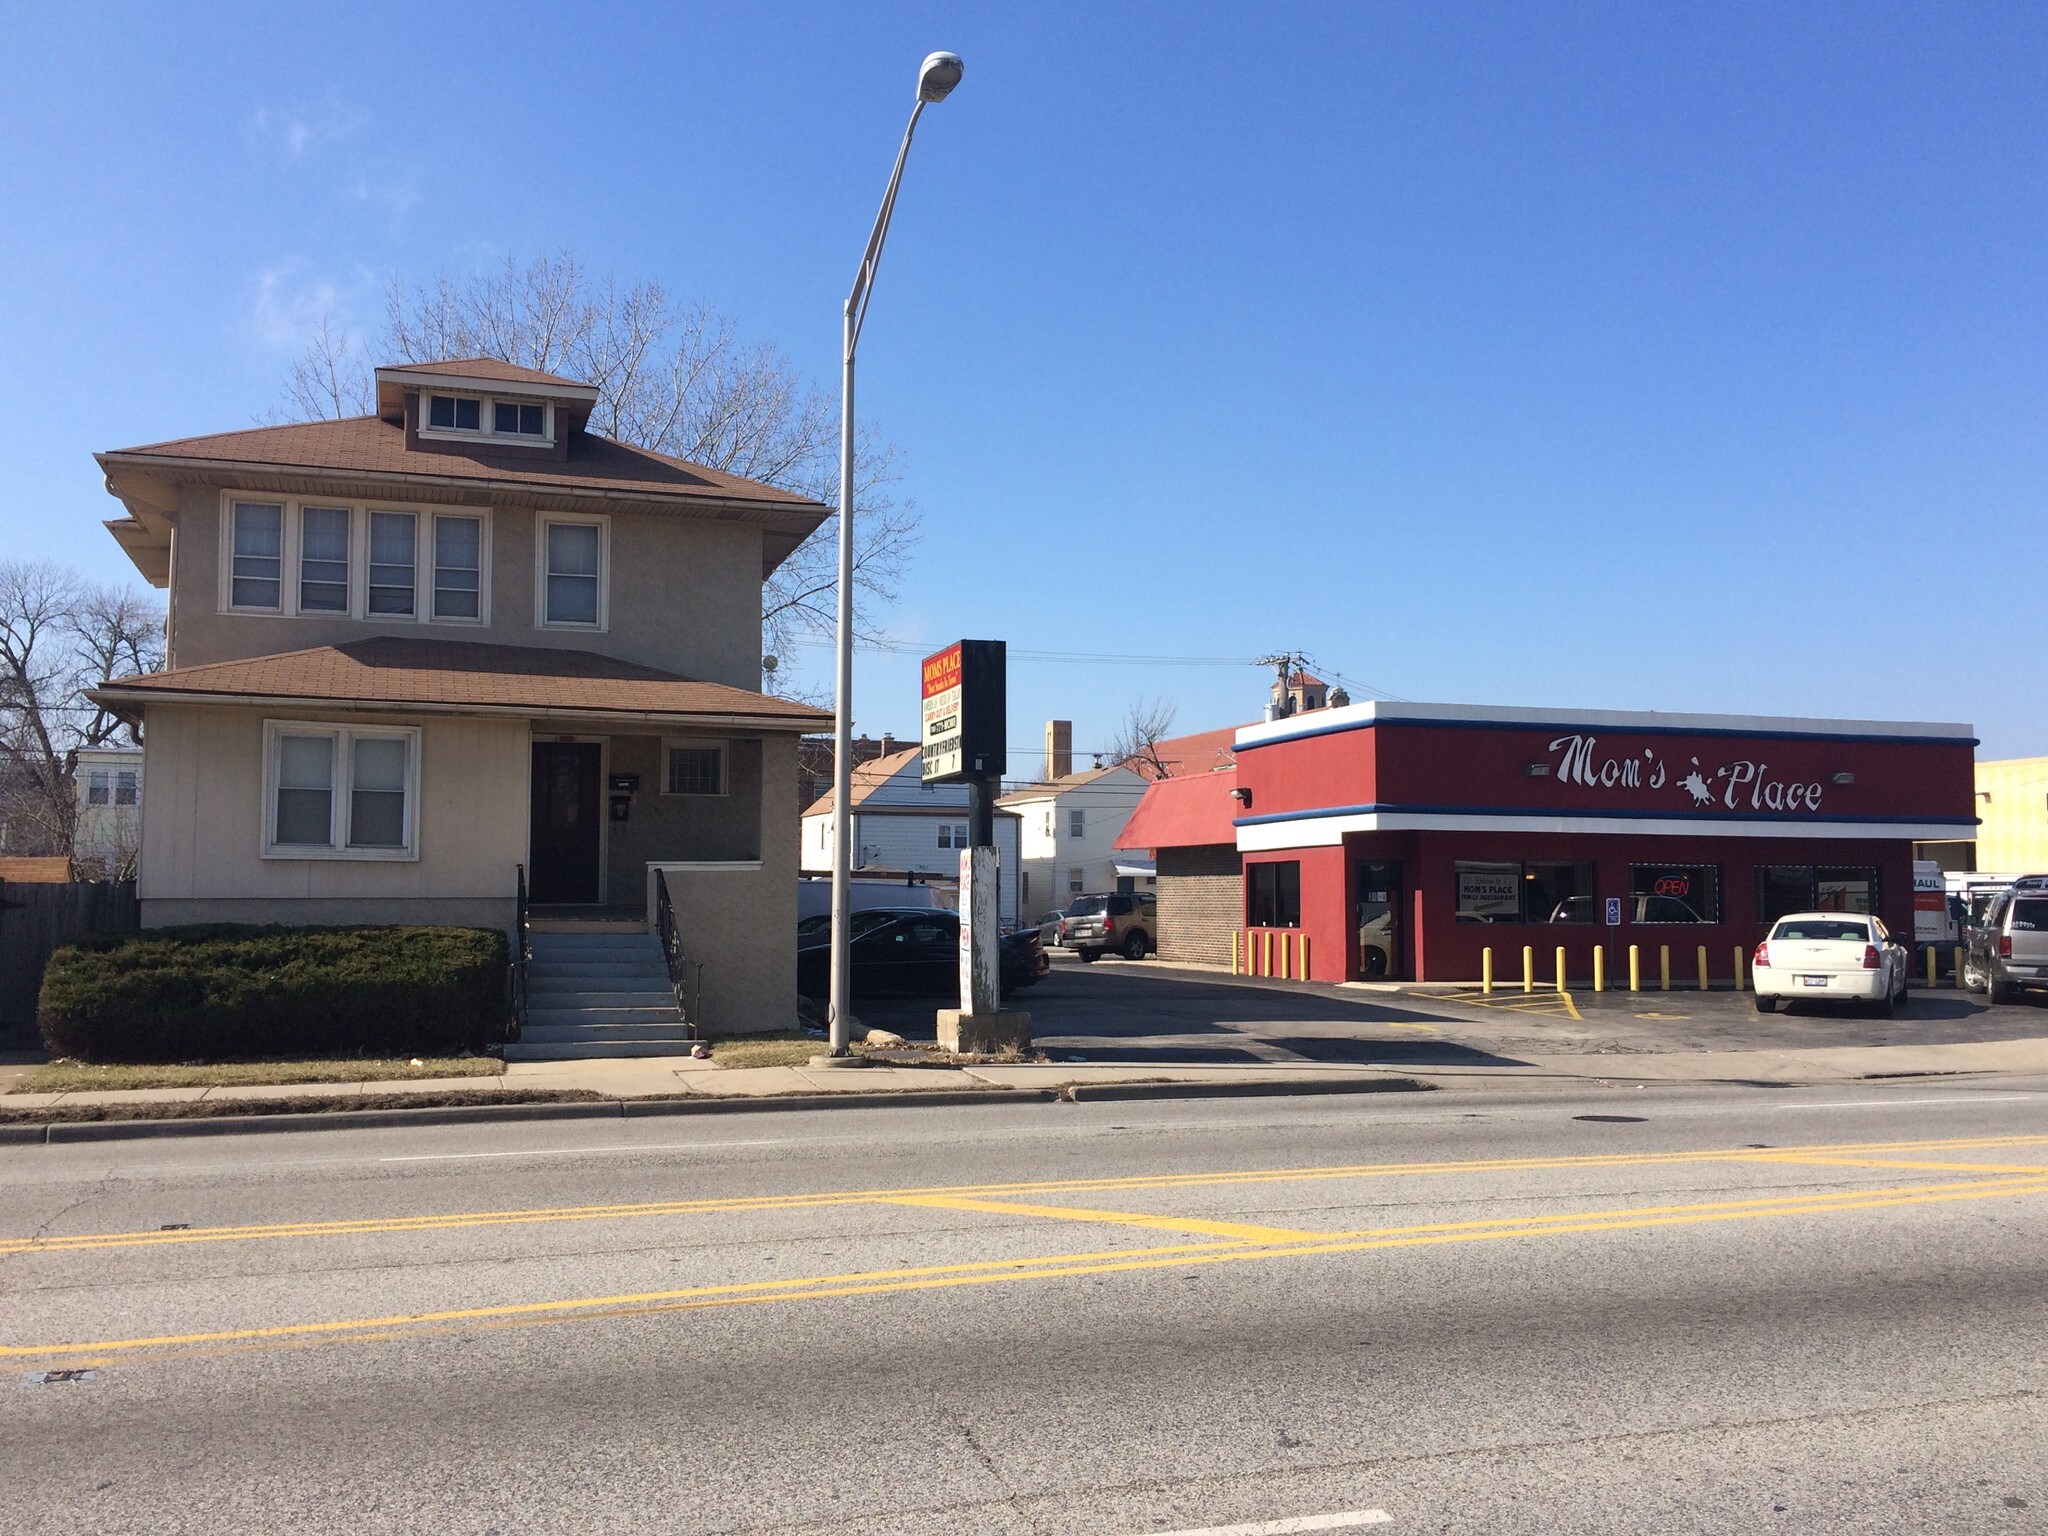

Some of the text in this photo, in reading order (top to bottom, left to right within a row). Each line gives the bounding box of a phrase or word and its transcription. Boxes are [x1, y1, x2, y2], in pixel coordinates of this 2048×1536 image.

[942, 651, 961, 674] PLACE
[1549, 734, 1822, 811] Mom's Place
[1463, 885, 1513, 894] MOM'S PLACE
[1654, 879, 1689, 895] OPEN
